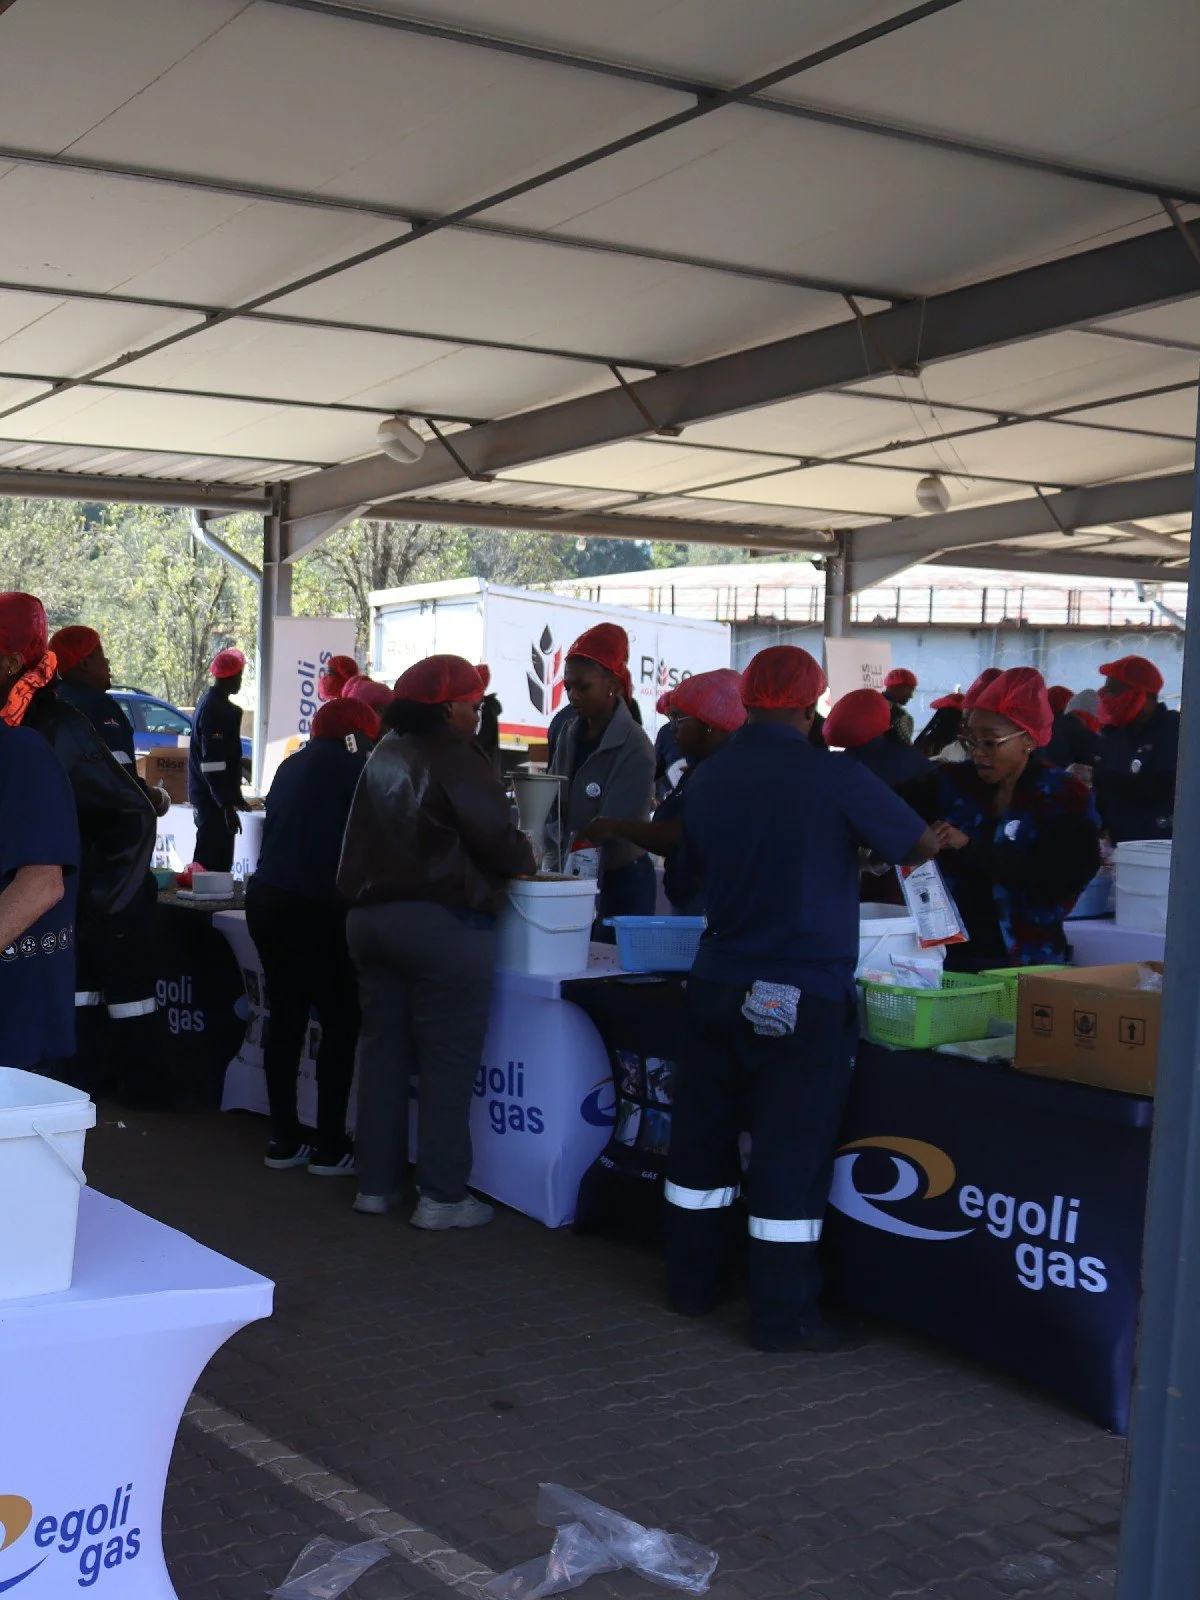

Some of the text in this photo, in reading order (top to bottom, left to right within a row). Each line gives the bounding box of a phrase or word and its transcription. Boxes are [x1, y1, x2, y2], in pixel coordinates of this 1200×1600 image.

[298, 660, 317, 734] egoli
[156, 975, 192, 1006] goli
[168, 1007, 205, 1034] gas
[473, 1061, 524, 1098] goli
[489, 1100, 545, 1135] gas
[959, 1184, 1081, 1244] egoli
[1015, 1243, 1108, 1293] gas
[34, 1482, 133, 1554] egoli
[78, 1527, 141, 1588] gas
